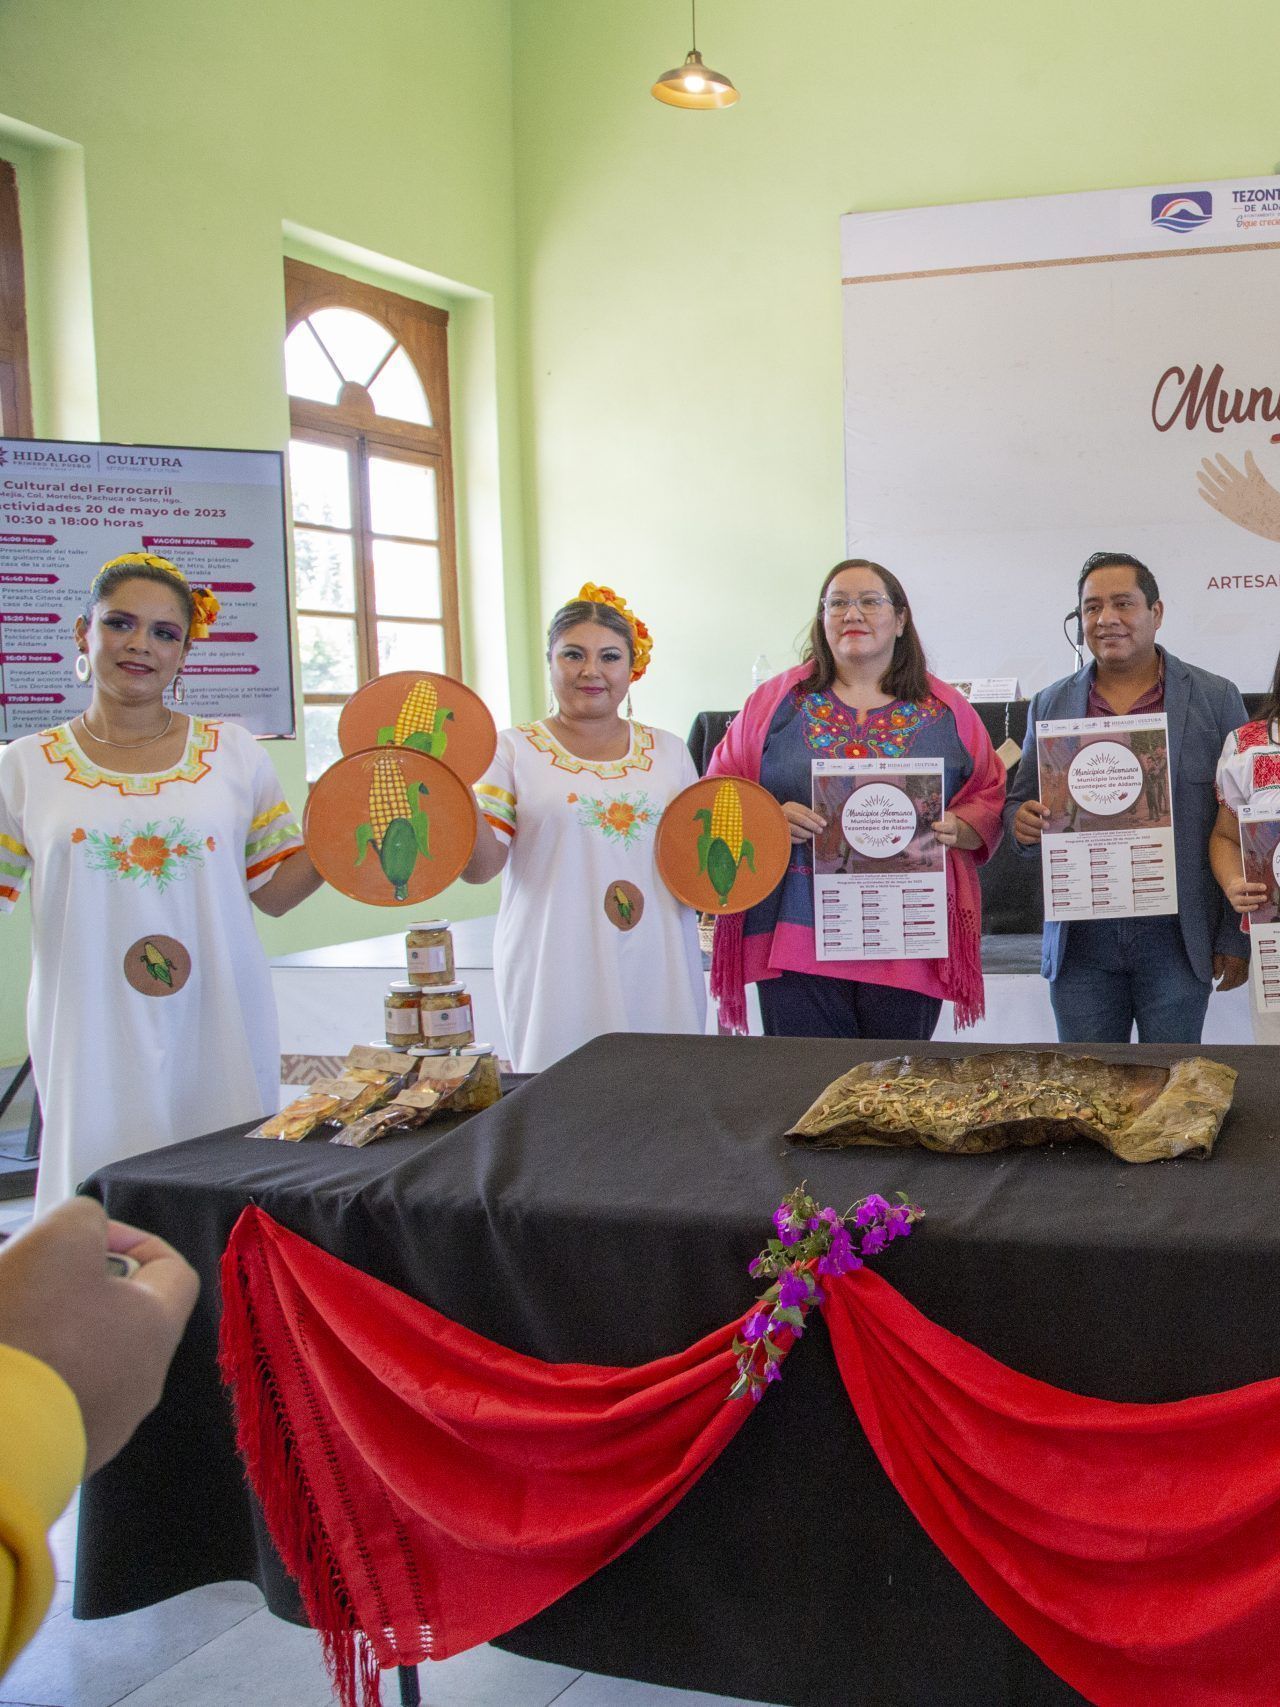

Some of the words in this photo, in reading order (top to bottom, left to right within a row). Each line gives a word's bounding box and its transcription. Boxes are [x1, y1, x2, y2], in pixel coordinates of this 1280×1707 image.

[13, 451, 91, 463] HIDALGO
[106, 455, 182, 468] CULTURA
[4, 480, 64, 492] Cultural
[70, 483, 92, 493] del
[98, 485, 172, 496] Ferrocarril
[0, 501, 81, 513] ctividades
[86, 504, 103, 513] 20
[108, 504, 125, 514] de
[130, 507, 168, 517] mayo
[173, 508, 190, 516] de
[194, 508, 226, 518] 2023
[5, 515, 43, 524] 10:30
[61, 516, 99, 526] 18:00
[104, 518, 144, 528] horas
